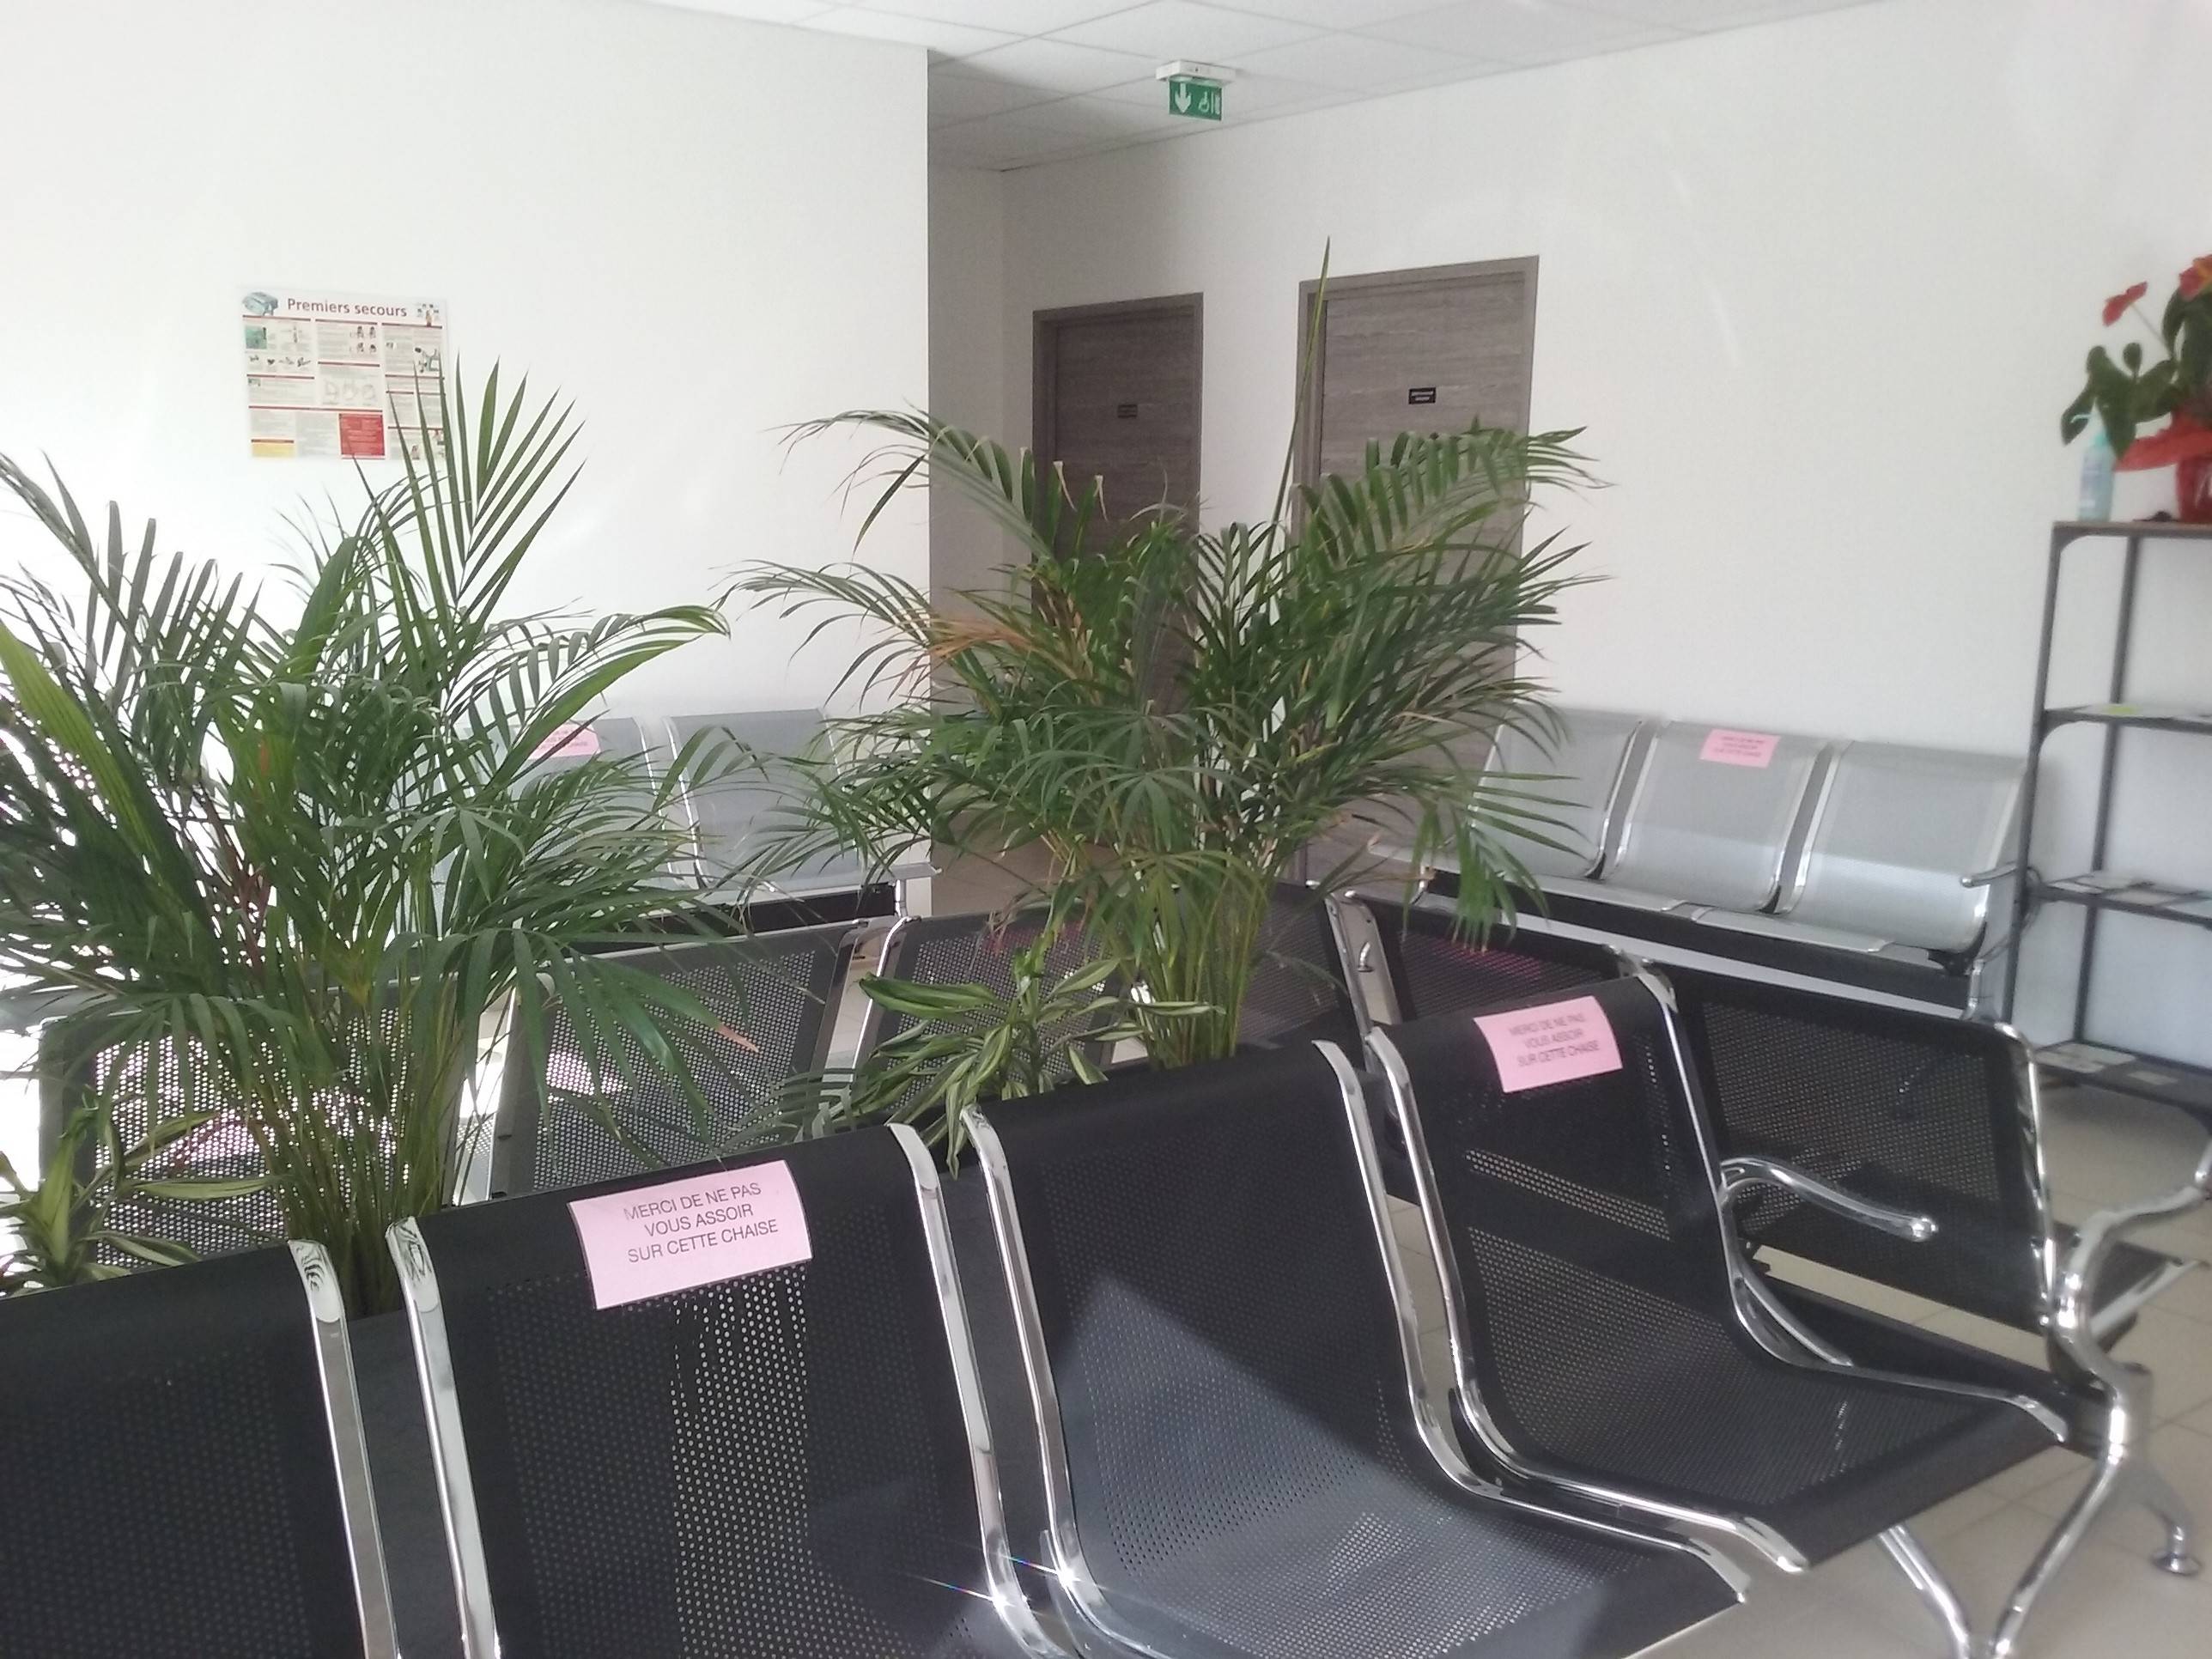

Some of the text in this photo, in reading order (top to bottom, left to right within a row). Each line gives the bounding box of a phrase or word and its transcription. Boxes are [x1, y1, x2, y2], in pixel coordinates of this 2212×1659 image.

[288, 298, 407, 317] Premiers secours
[623, 1182, 762, 1220] MERCI DE NE PAS
[644, 1203, 754, 1237] VOUS ASSOIR
[628, 1219, 778, 1263] SUR CETTE CHAISE
